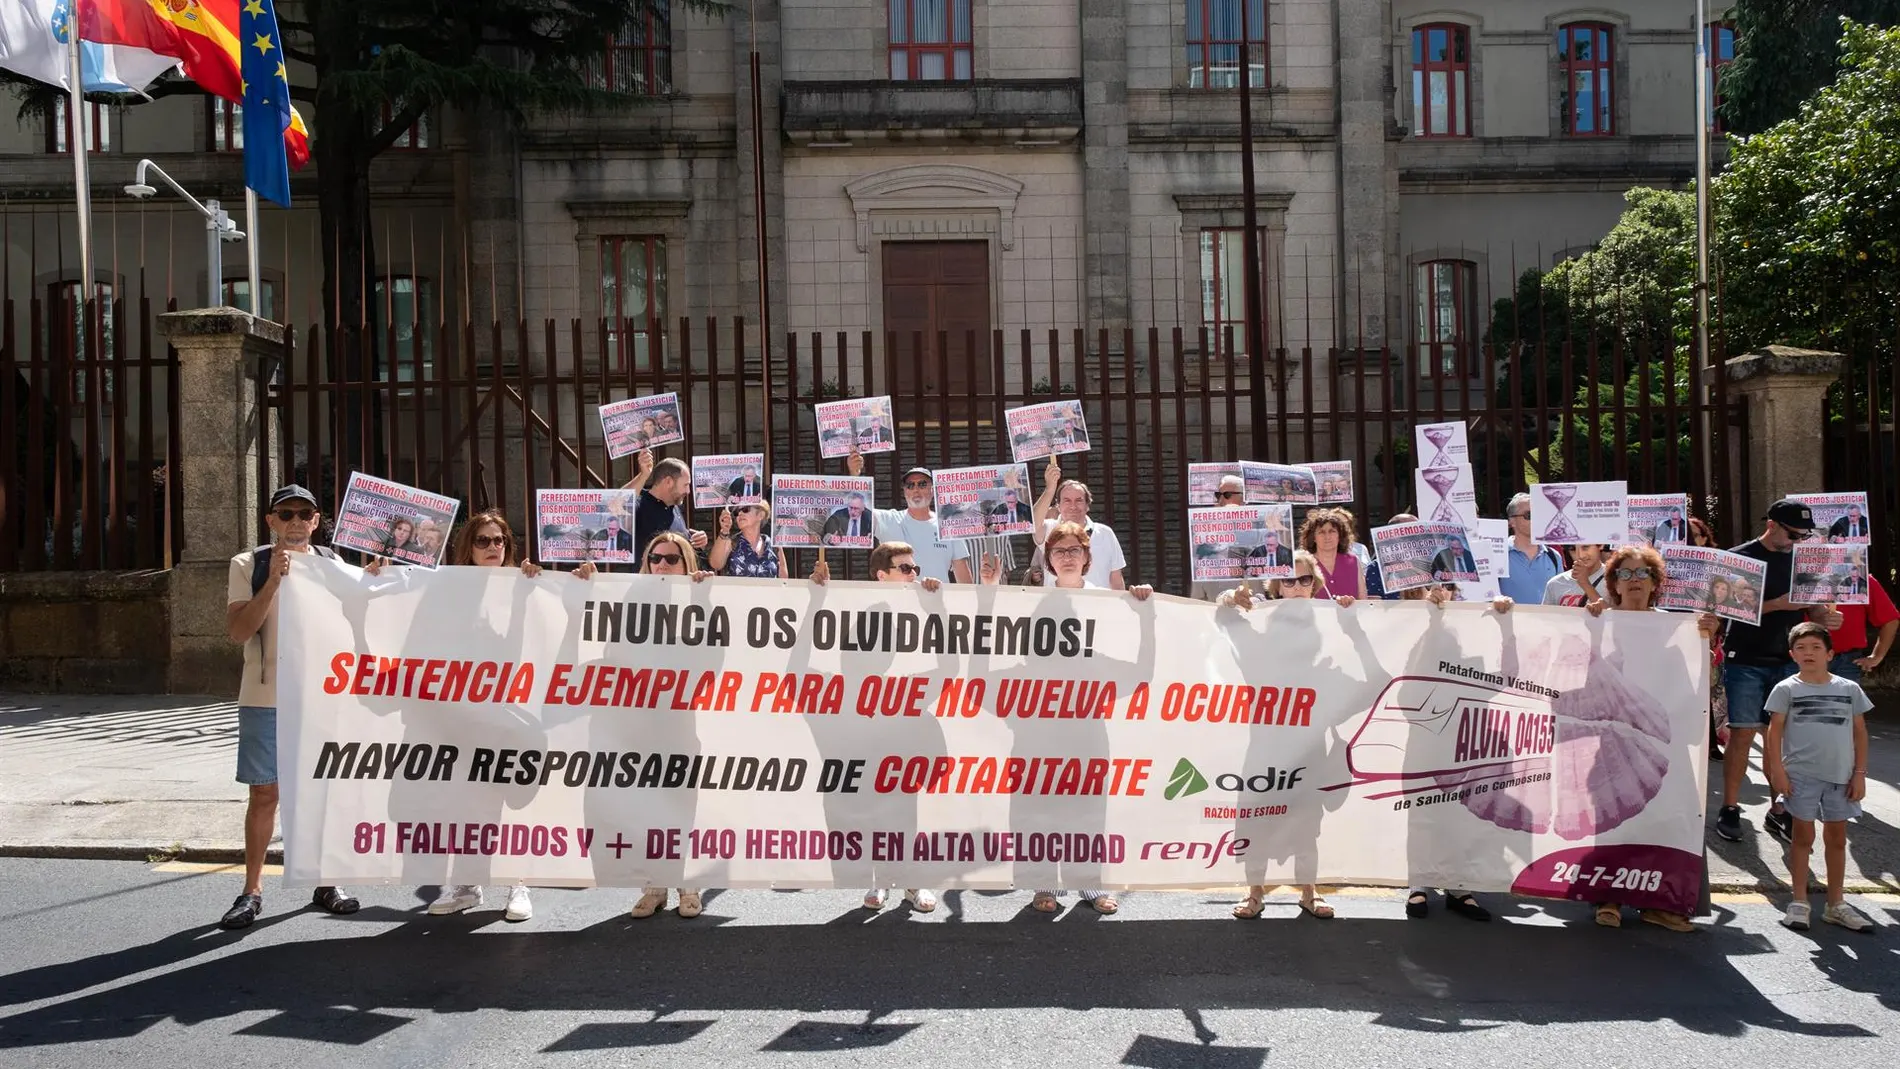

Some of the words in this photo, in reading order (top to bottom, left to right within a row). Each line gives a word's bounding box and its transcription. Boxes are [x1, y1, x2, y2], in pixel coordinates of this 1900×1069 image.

[937, 469, 998, 482] PERFECTAMENTE
[777, 479, 826, 489] QUEREMOS
[830, 480, 869, 490] JUSTICIA
[977, 481, 993, 489] POR
[355, 477, 407, 500] QUEREMOS
[409, 493, 452, 513] JUSTICIA
[541, 493, 602, 503] PERFECTAMENTE
[777, 496, 785, 505] EL
[787, 496, 814, 505] ESTADO
[816, 496, 844, 505] CONTRA
[938, 496, 946, 505] EL
[950, 493, 978, 503] ESTADO
[1832, 495, 1864, 503] JUSTICIA
[348, 502, 363, 512] LAS
[350, 492, 360, 501] EL
[361, 495, 387, 509] ESTADO
[389, 503, 418, 516] CONTRA
[581, 504, 597, 513] POR
[777, 507, 790, 515] LAS
[541, 516, 549, 525] EL
[552, 516, 580, 525] ESTADO
[1192, 510, 1258, 520] PERFECTAMENTE
[1236, 521, 1252, 531] POR
[1377, 525, 1425, 540] QUEREMOS
[1427, 524, 1463, 534] JUSTICIA
[347, 535, 385, 552] FALLECIDOS
[1194, 535, 1202, 544] EL
[1205, 534, 1235, 543] ESTADO
[1390, 541, 1417, 552] ESTADO
[1666, 548, 1718, 561] QUEREMOS
[1721, 555, 1760, 573] JUSTICIA
[1674, 561, 1701, 571] ESTADO
[1703, 565, 1731, 576] CONTRA
[582, 600, 730, 647] ¡NUNCA
[746, 606, 797, 650] OS
[812, 608, 1096, 658] OLVIDAREMOS!
[1438, 660, 1504, 686] Plataforma
[1506, 675, 1561, 700] Víctimas
[323, 651, 534, 704] SENTENCIA
[544, 663, 743, 712] EJEMPLAR
[750, 672, 845, 715] PARA
[855, 674, 930, 719] QUE
[934, 677, 986, 719] NO
[995, 679, 1117, 720] VUELVA
[1125, 681, 1150, 722] A
[1160, 682, 1317, 728] OCURRIR
[1453, 706, 1510, 763] ALVIA
[1514, 715, 1556, 756] 04155
[312, 741, 459, 782] MAYOR
[467, 747, 807, 794] RESPONSABILIDAD
[816, 758, 866, 795] DE
[873, 755, 1152, 797] CORTABITARTE
[1214, 766, 1307, 794] adif
[1393, 799, 1412, 812] de
[1416, 788, 1471, 808] Santiago
[1475, 782, 1490, 796] de
[1492, 771, 1552, 794] Compostela
[1239, 807, 1252, 819] DE
[1253, 804, 1288, 818] ESTADO
[353, 822, 386, 855] 81
[395, 822, 568, 857] FALLECIDOS
[576, 828, 594, 858] Y
[605, 832, 633, 860] +
[645, 828, 681, 860] DE
[688, 828, 736, 860] 140
[745, 828, 863, 863] HERIDOS
[872, 831, 904, 862] EN
[912, 831, 976, 863] ALTA
[983, 831, 1126, 865] VELOCIDAD
[1139, 829, 1250, 869] renfe
[1549, 861, 1663, 892] 24-7-2013
